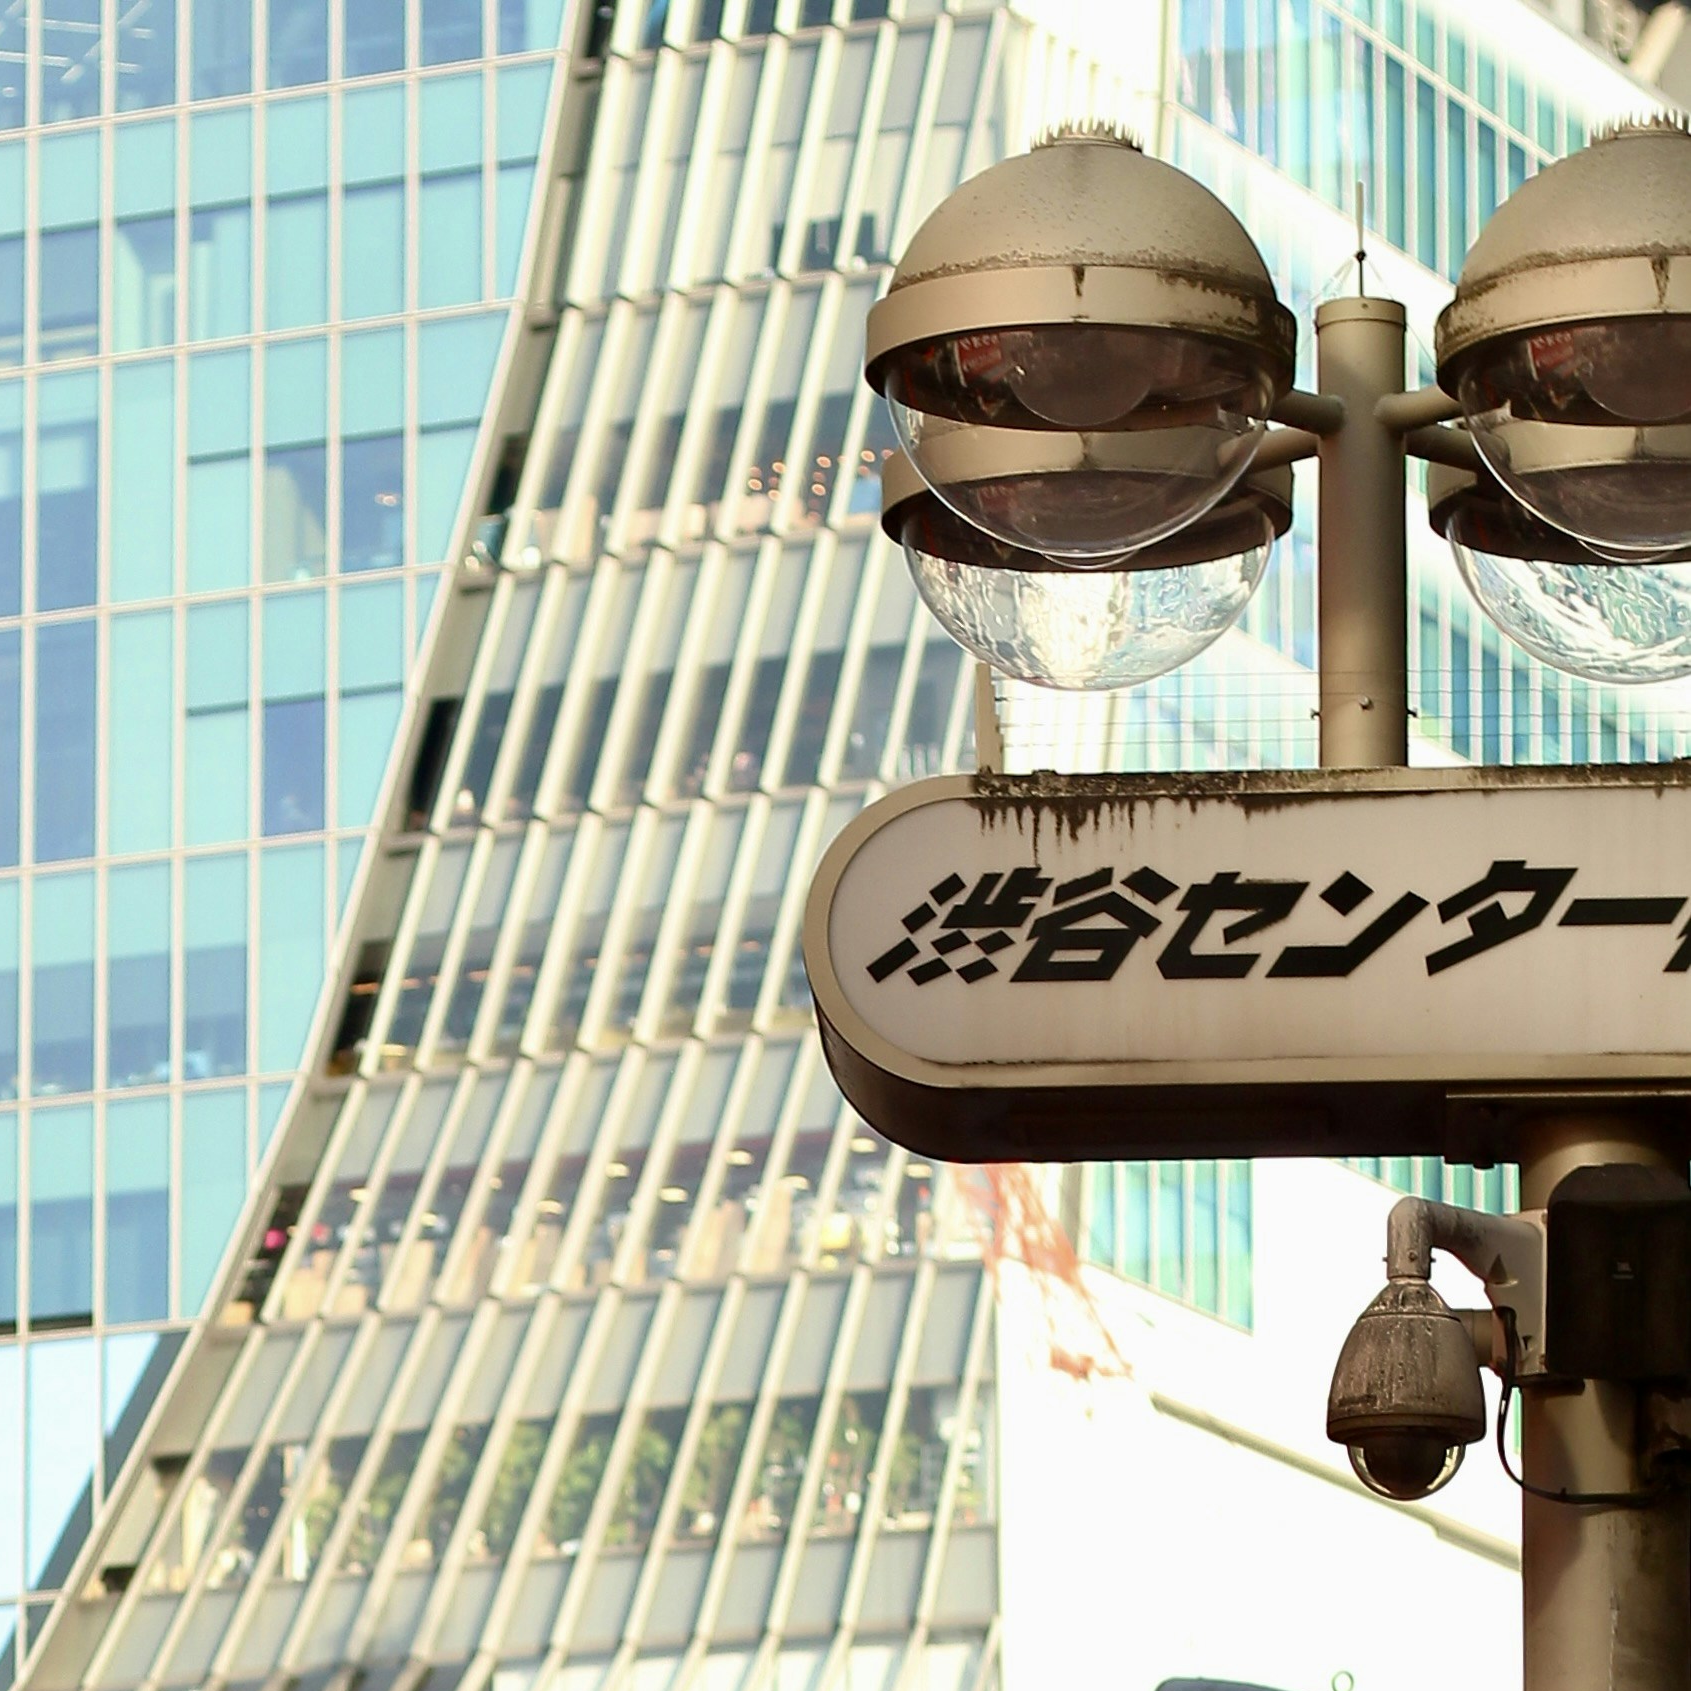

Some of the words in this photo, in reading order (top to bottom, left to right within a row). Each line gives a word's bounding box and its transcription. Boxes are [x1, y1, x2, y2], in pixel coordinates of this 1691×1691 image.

[866, 860, 1691, 985] 渋谷センター
